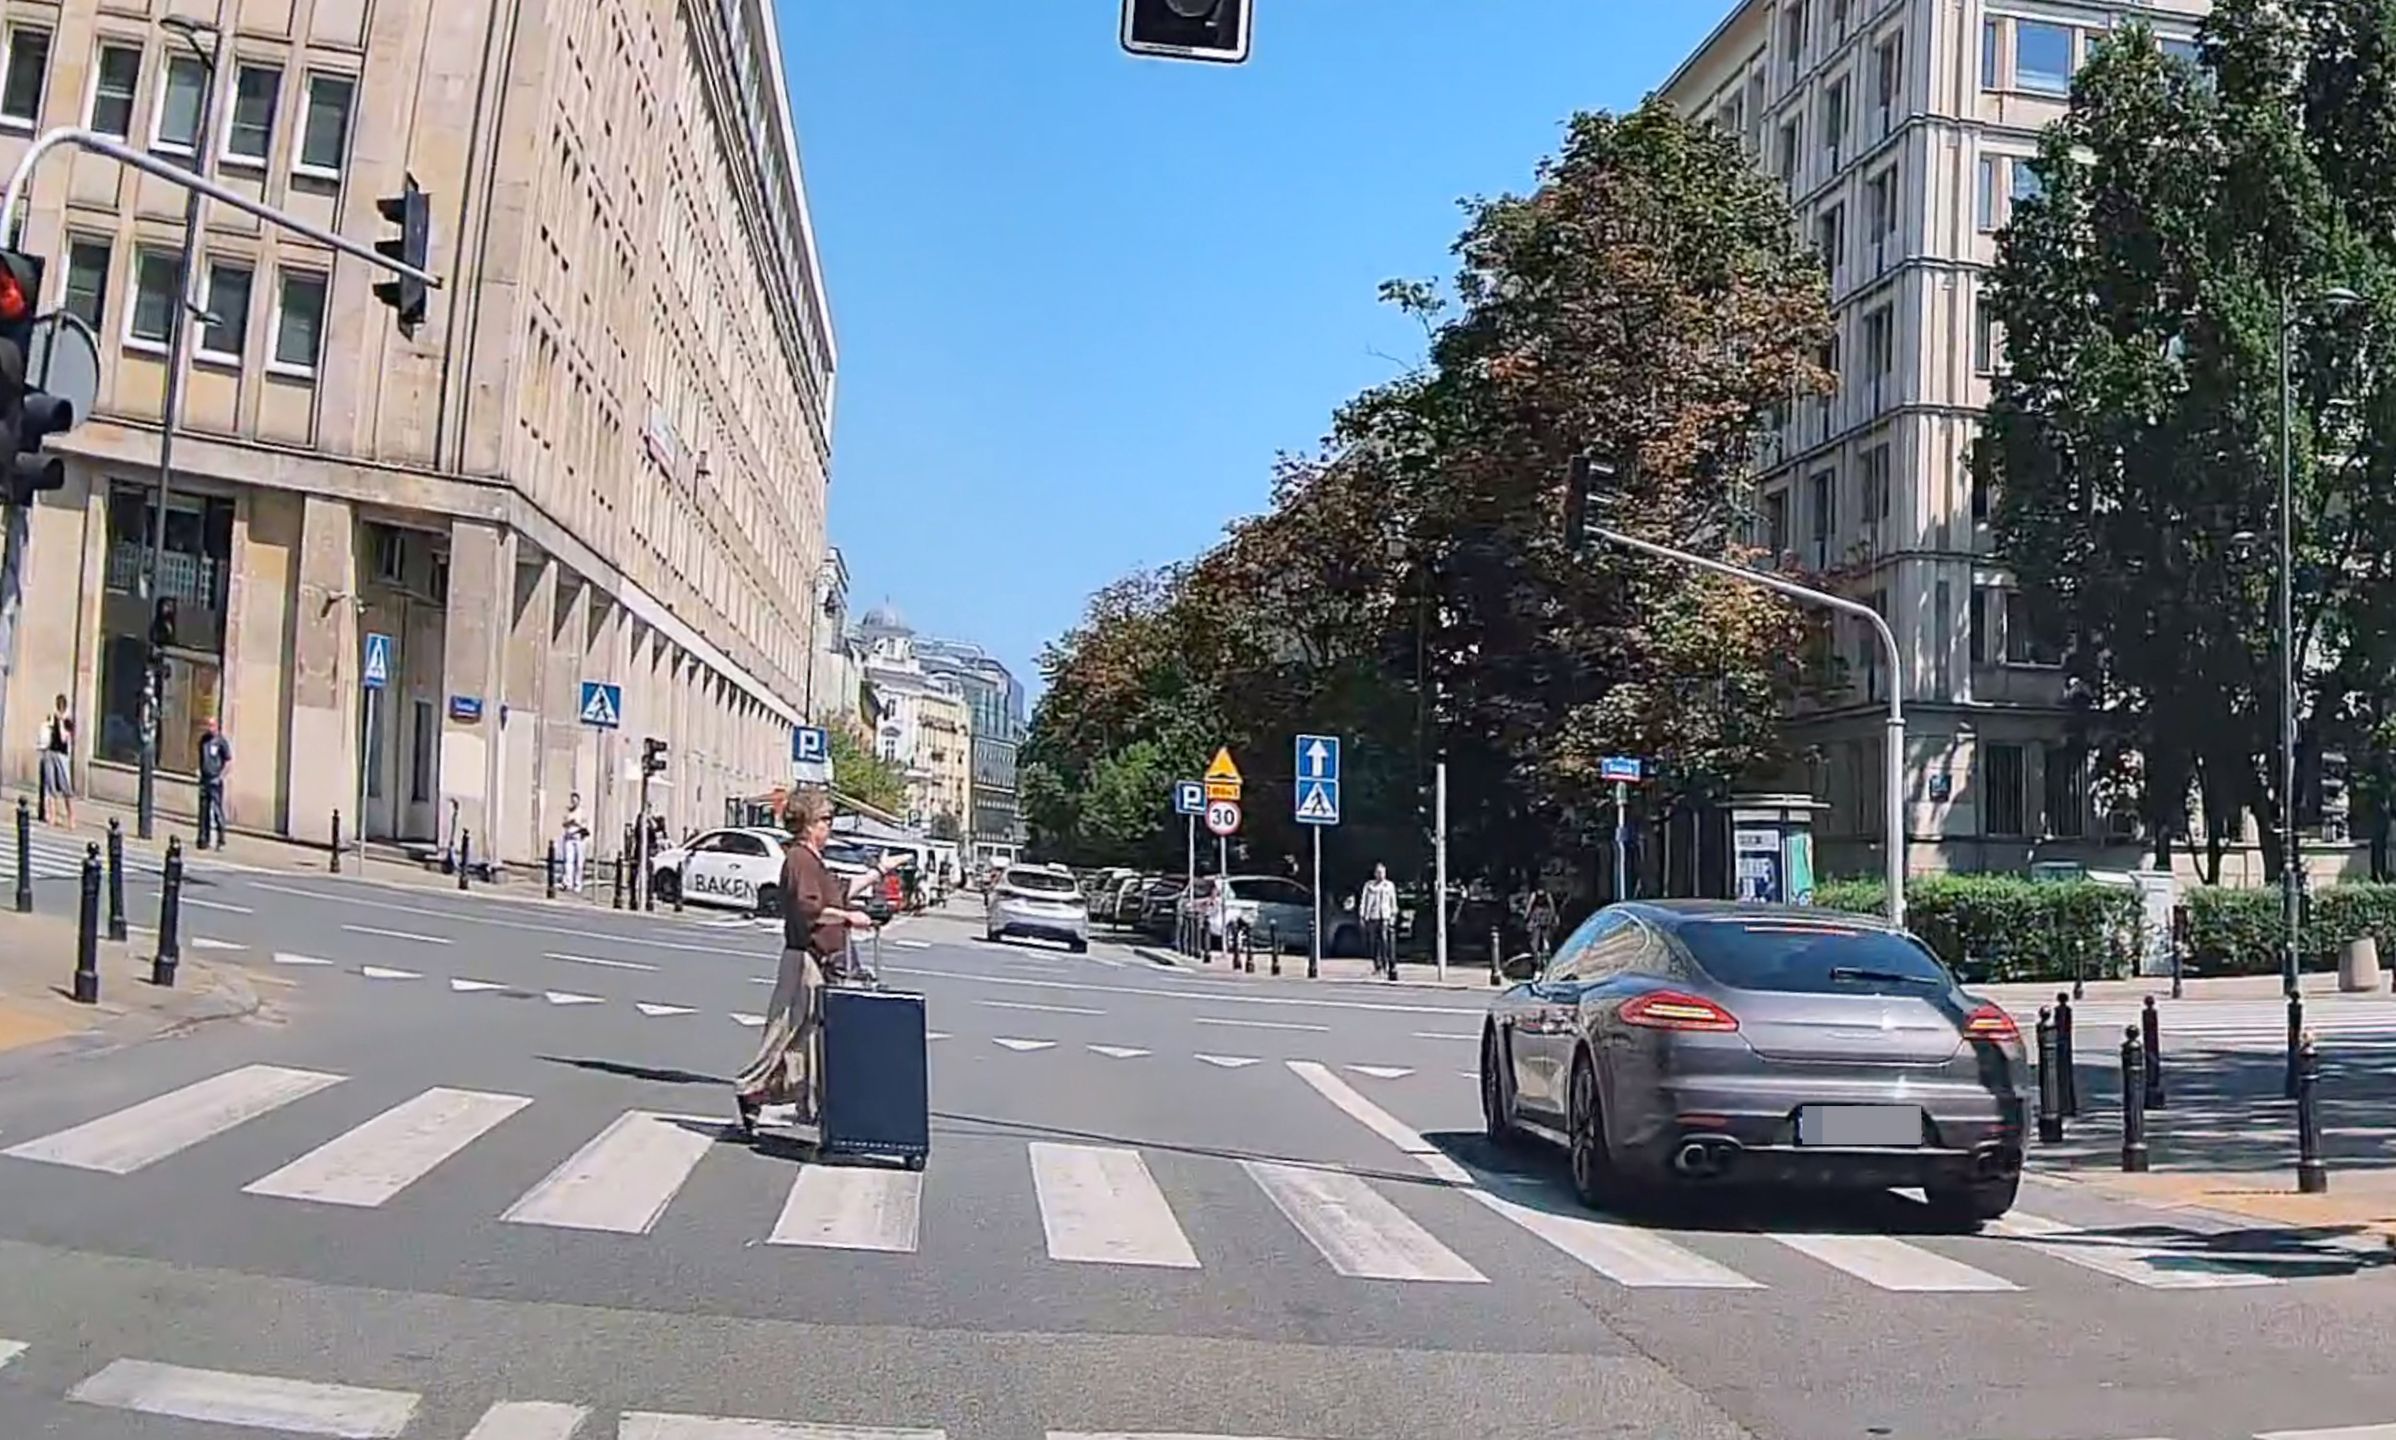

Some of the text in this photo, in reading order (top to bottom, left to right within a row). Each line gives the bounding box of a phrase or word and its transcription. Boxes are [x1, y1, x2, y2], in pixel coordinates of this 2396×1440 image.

[799, 730, 819, 758] P
[1183, 784, 1201, 809] P
[1212, 808, 1235, 826] 30
[695, 873, 758, 899] BAKEN
